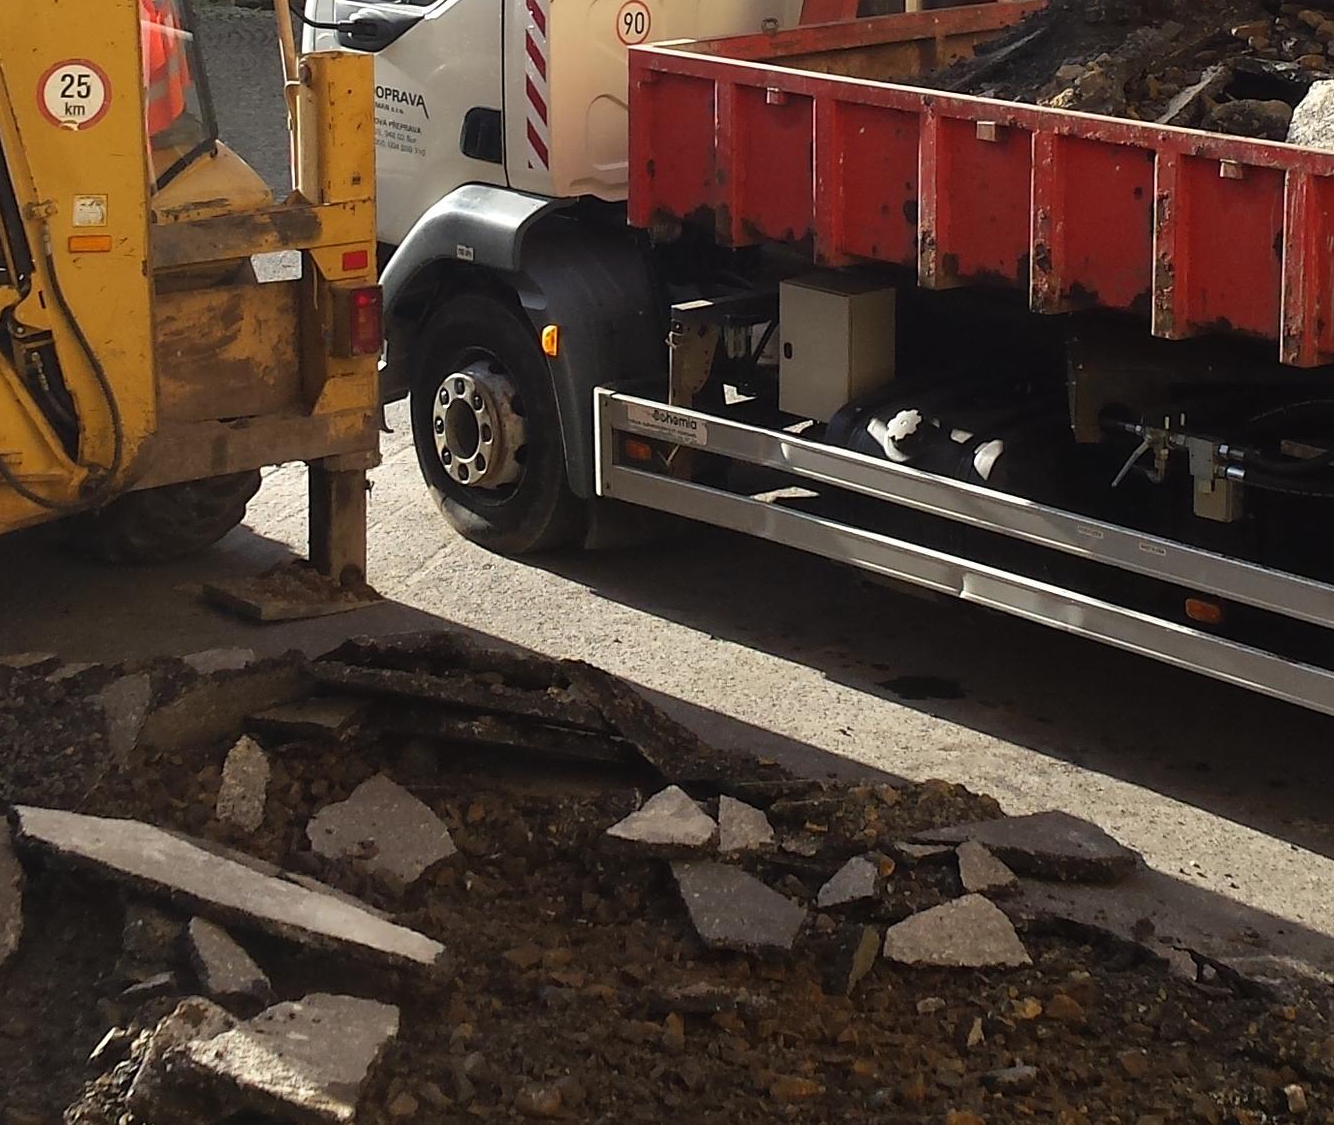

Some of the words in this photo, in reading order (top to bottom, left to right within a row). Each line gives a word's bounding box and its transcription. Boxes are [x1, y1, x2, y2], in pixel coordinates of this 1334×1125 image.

[624, 12, 645, 35] 90
[60, 74, 91, 99] 25
[65, 102, 85, 116] km
[375, 85, 429, 121] OPRAVA
